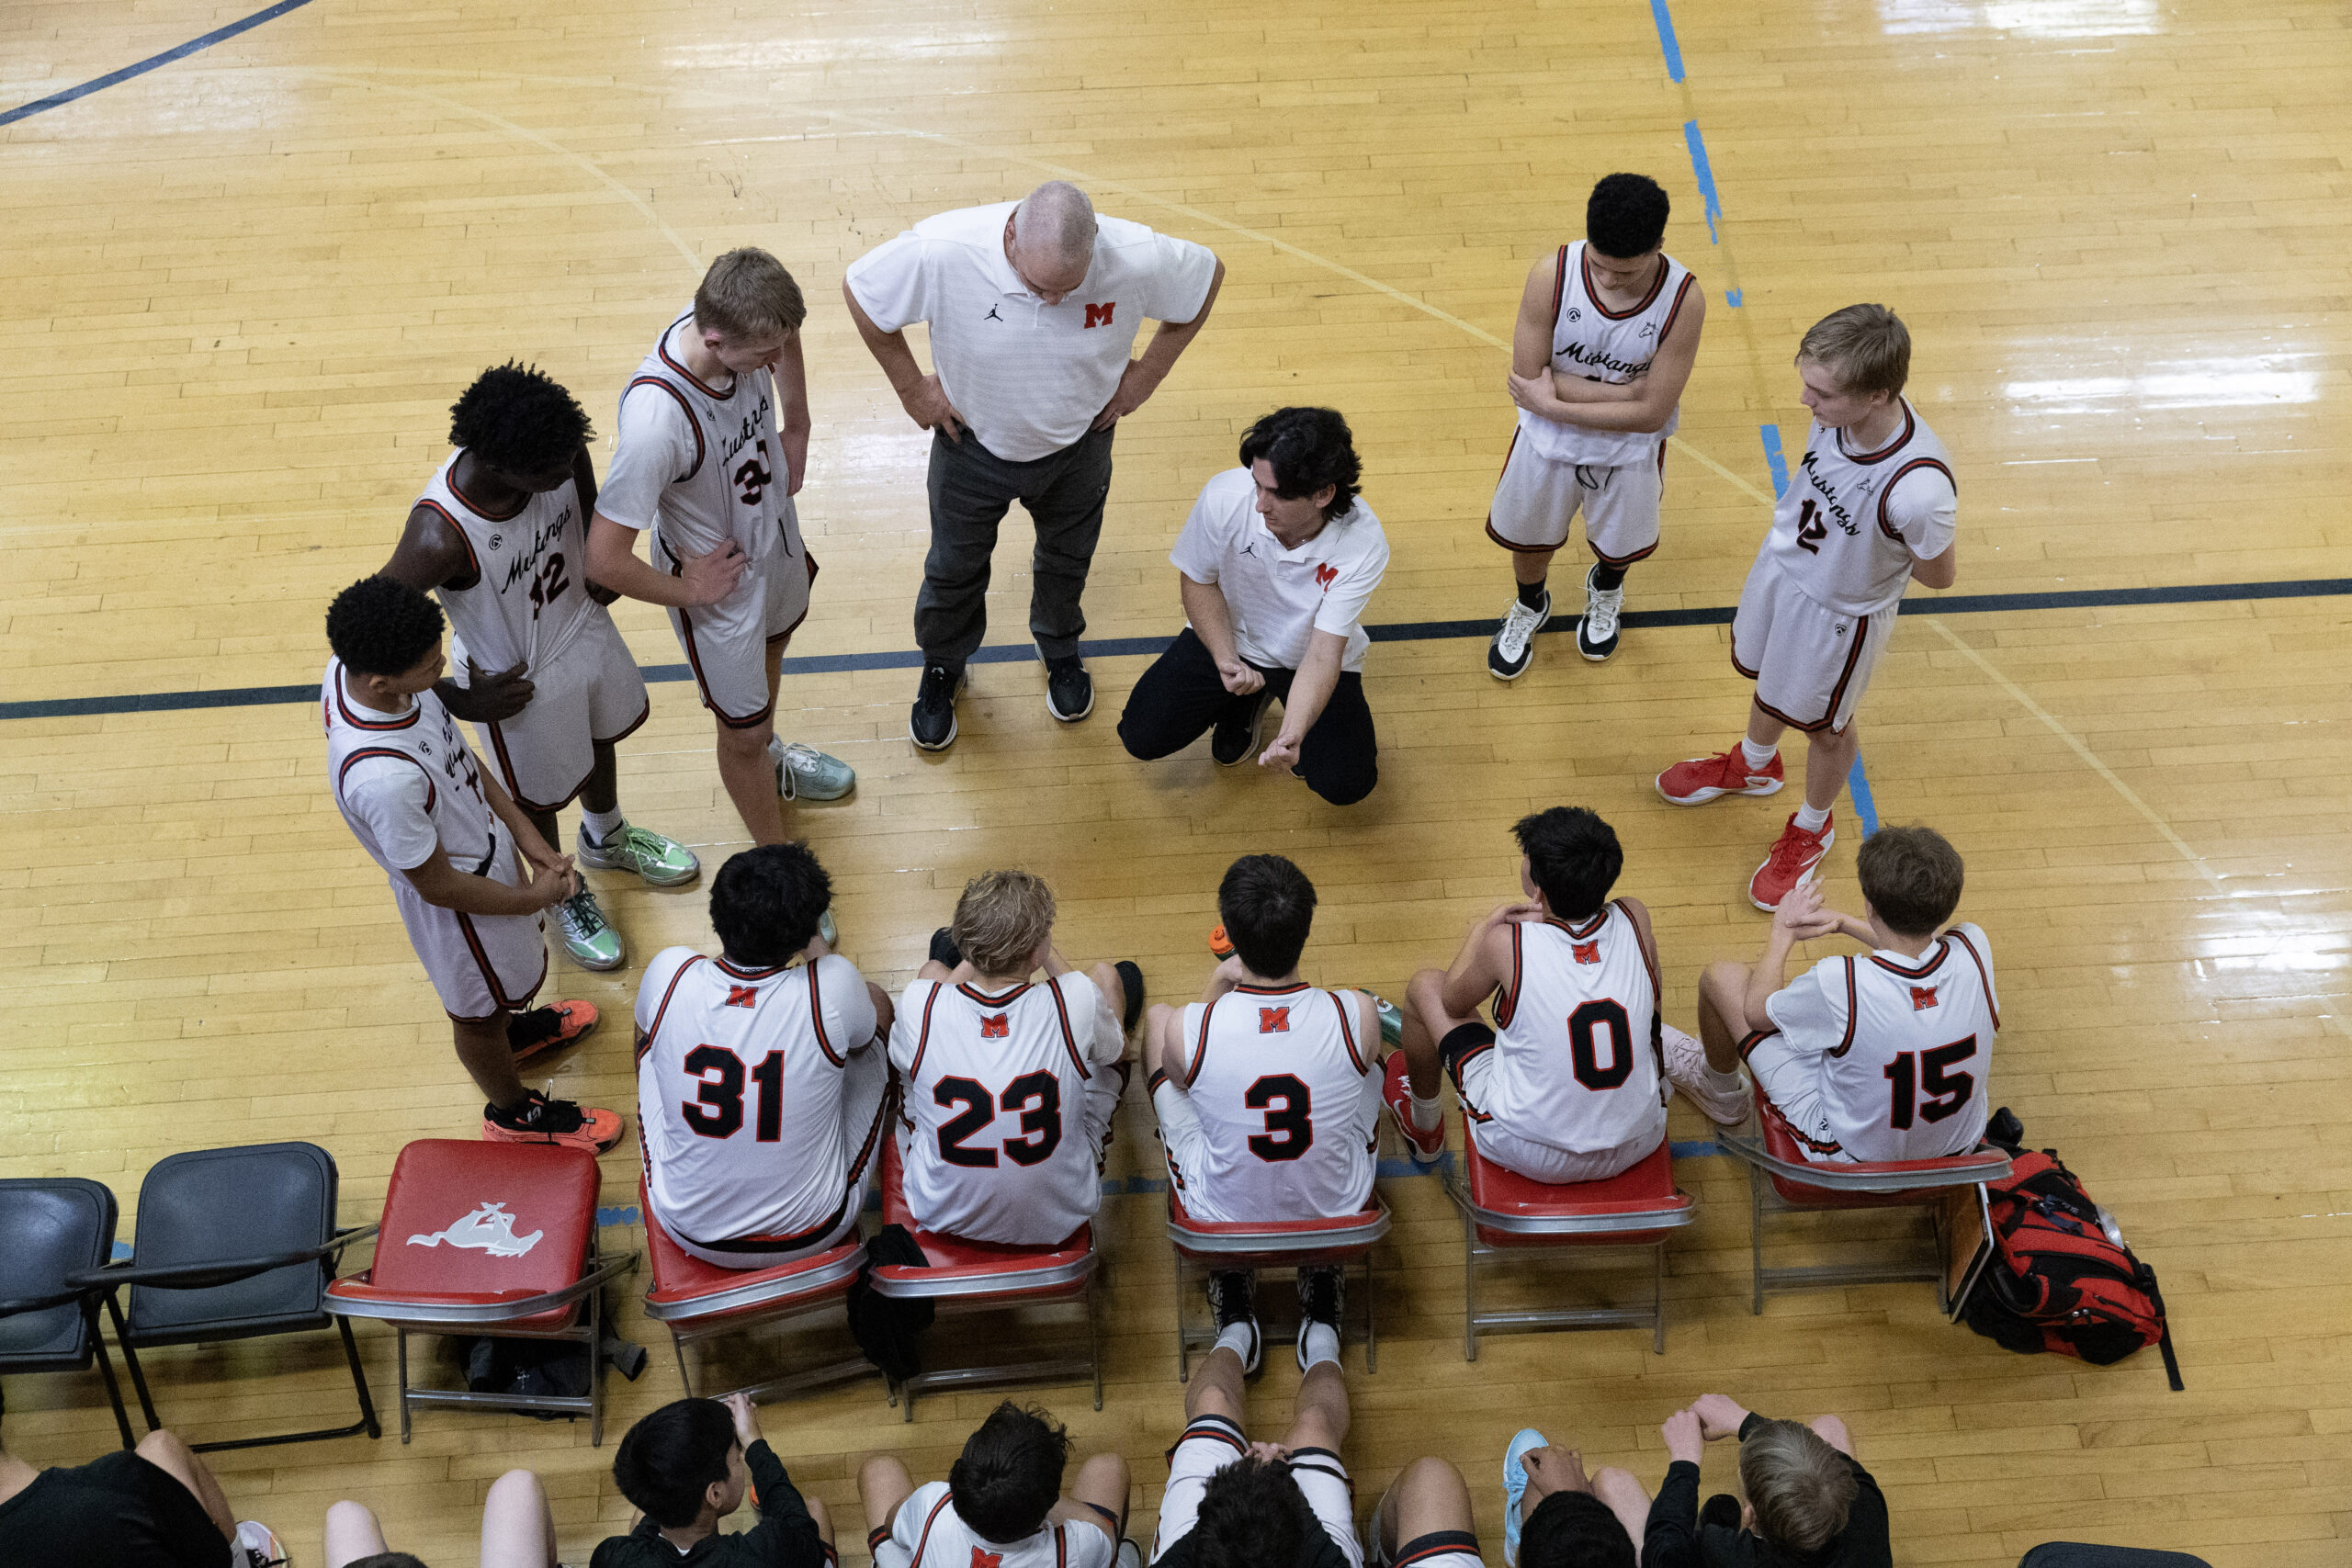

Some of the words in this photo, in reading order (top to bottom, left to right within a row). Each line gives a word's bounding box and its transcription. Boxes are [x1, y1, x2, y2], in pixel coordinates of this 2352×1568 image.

[1084, 302, 1115, 329] M
[1796, 499, 1827, 557] 12
[1316, 562, 1339, 593] M
[1571, 940, 1600, 964] M
[725, 985, 759, 1009] M
[1910, 985, 1939, 1010] M
[980, 1012, 1010, 1038] M
[1260, 1007, 1290, 1033] M
[1567, 998, 1634, 1091] 0
[682, 1043, 785, 1142] 31
[1884, 1032, 1976, 1131] 15
[933, 1068, 1062, 1168] 23
[1245, 1073, 1314, 1163] 3
